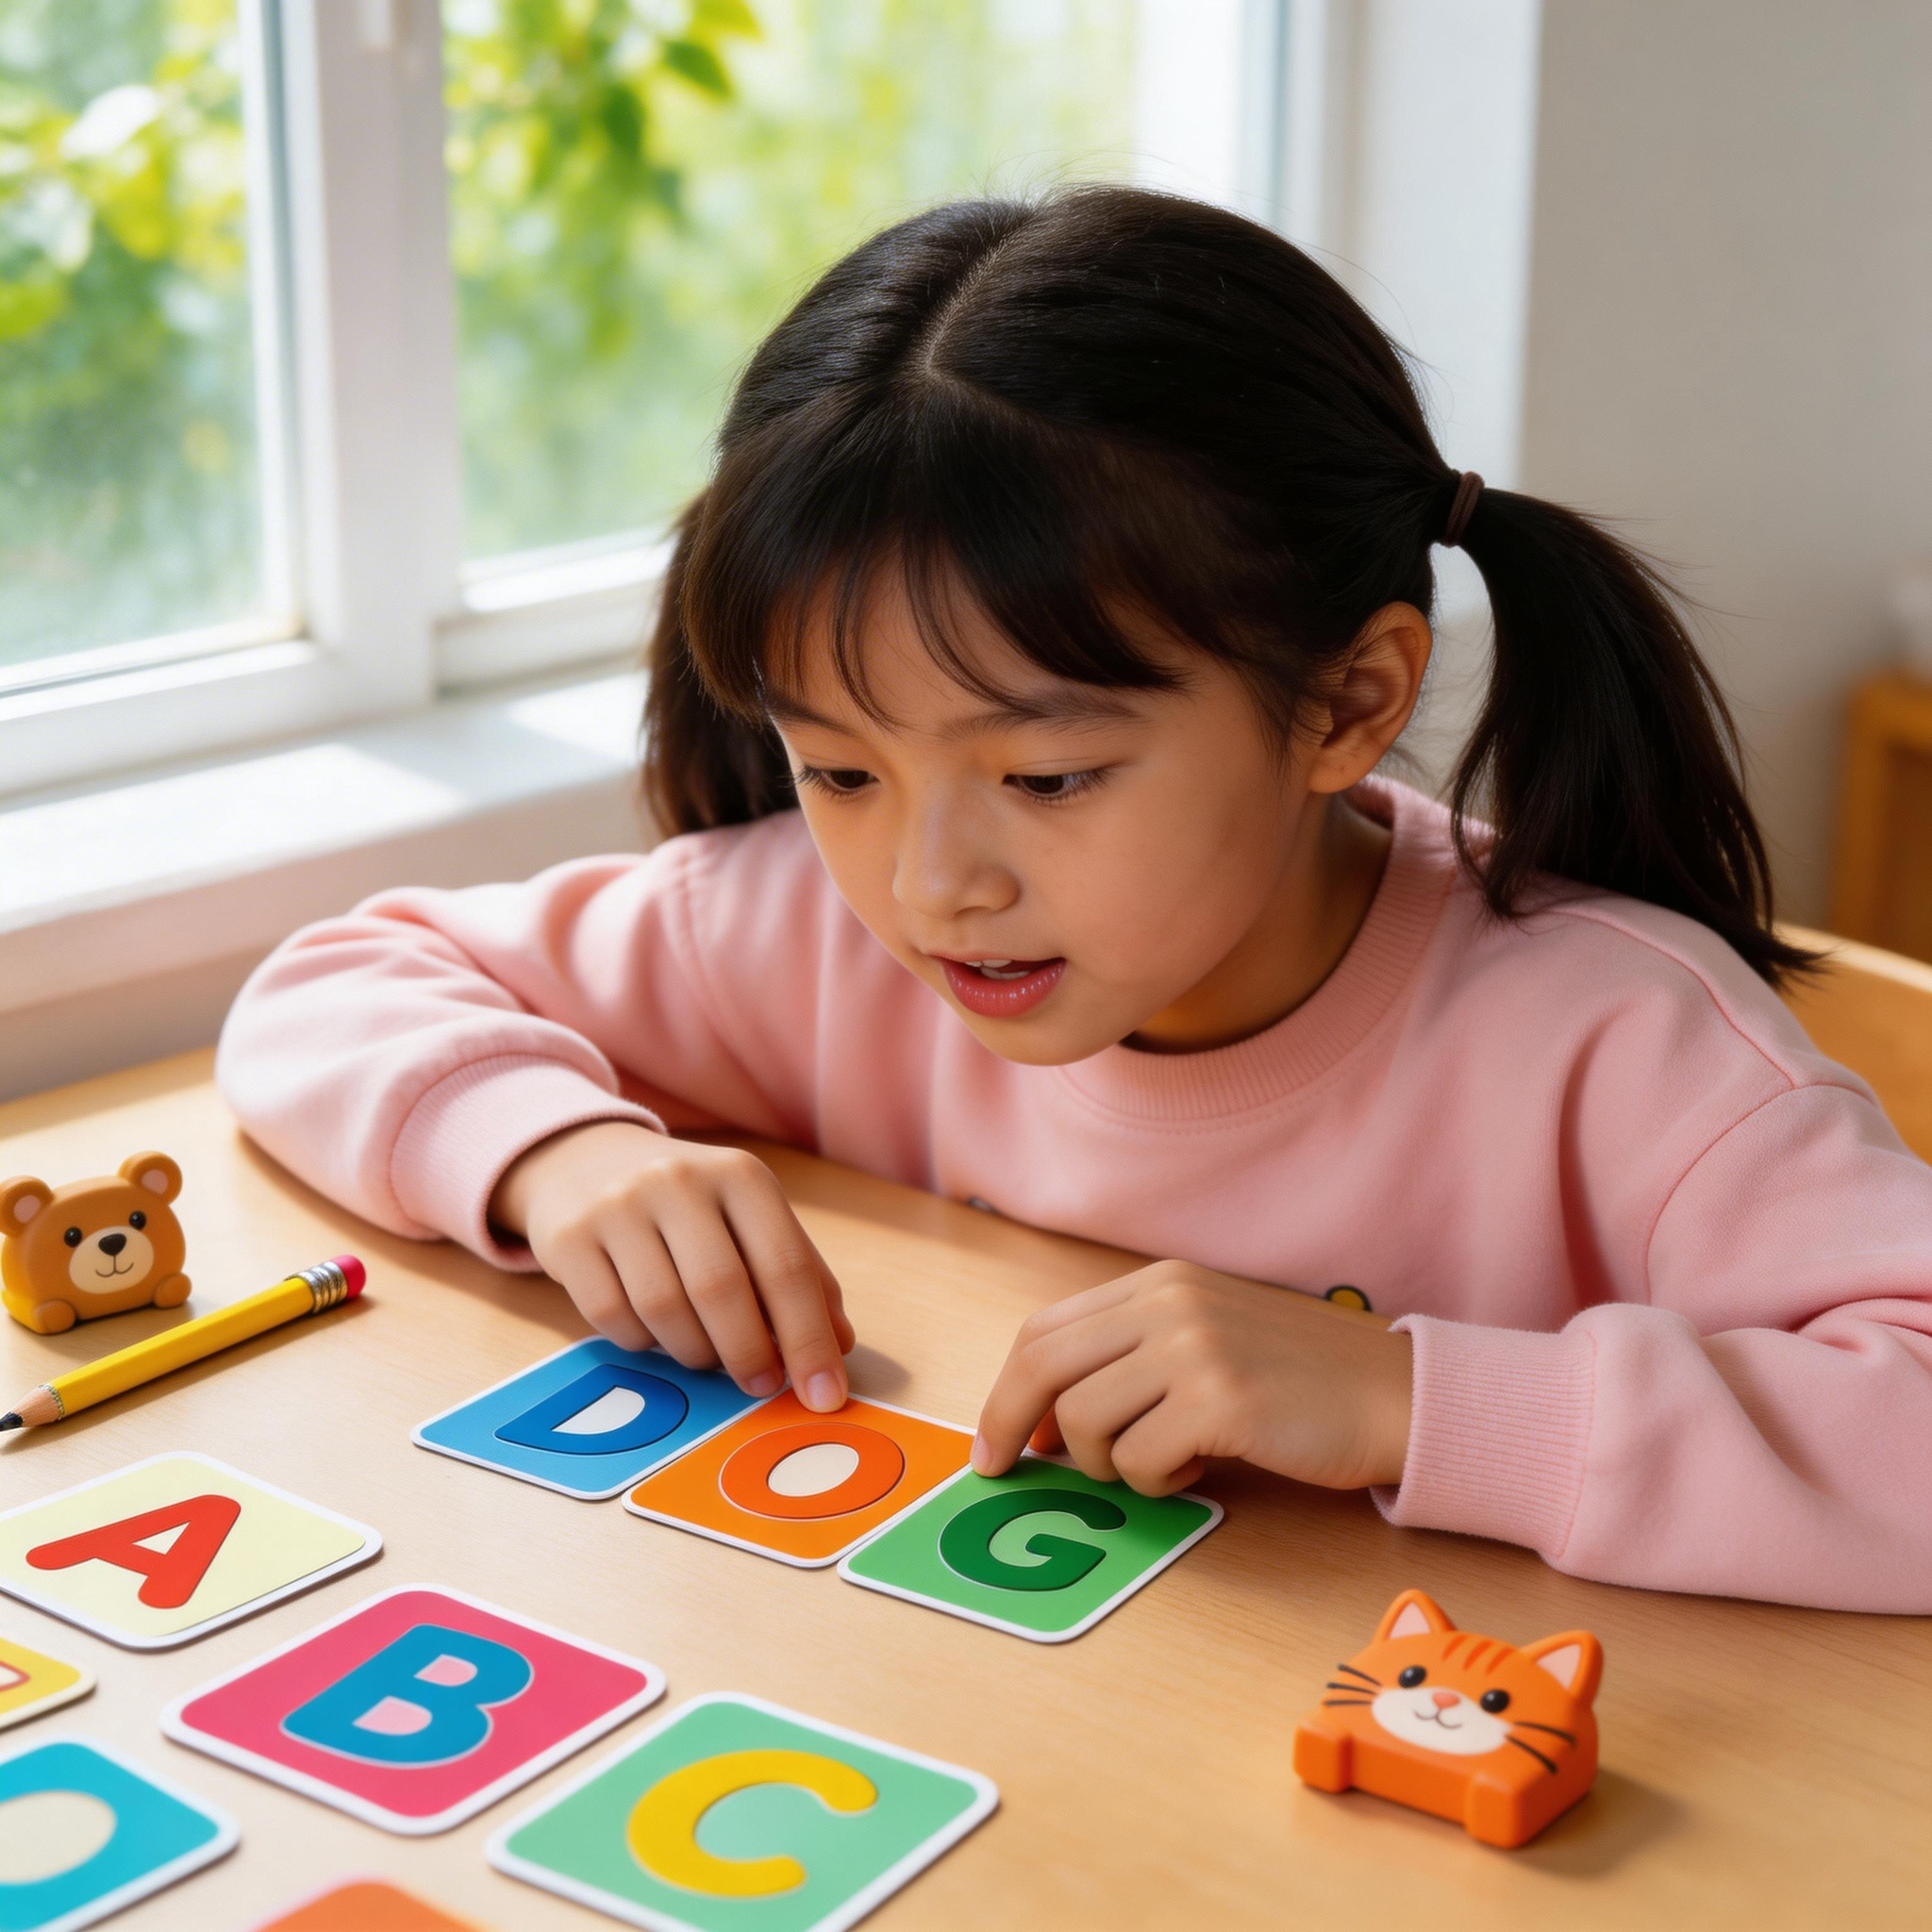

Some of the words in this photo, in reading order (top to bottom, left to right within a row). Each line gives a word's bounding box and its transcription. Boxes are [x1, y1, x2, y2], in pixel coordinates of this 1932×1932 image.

[25, 1494, 242, 1609] A
[281, 1624, 534, 1767] B
[626, 1748, 878, 1898] C
